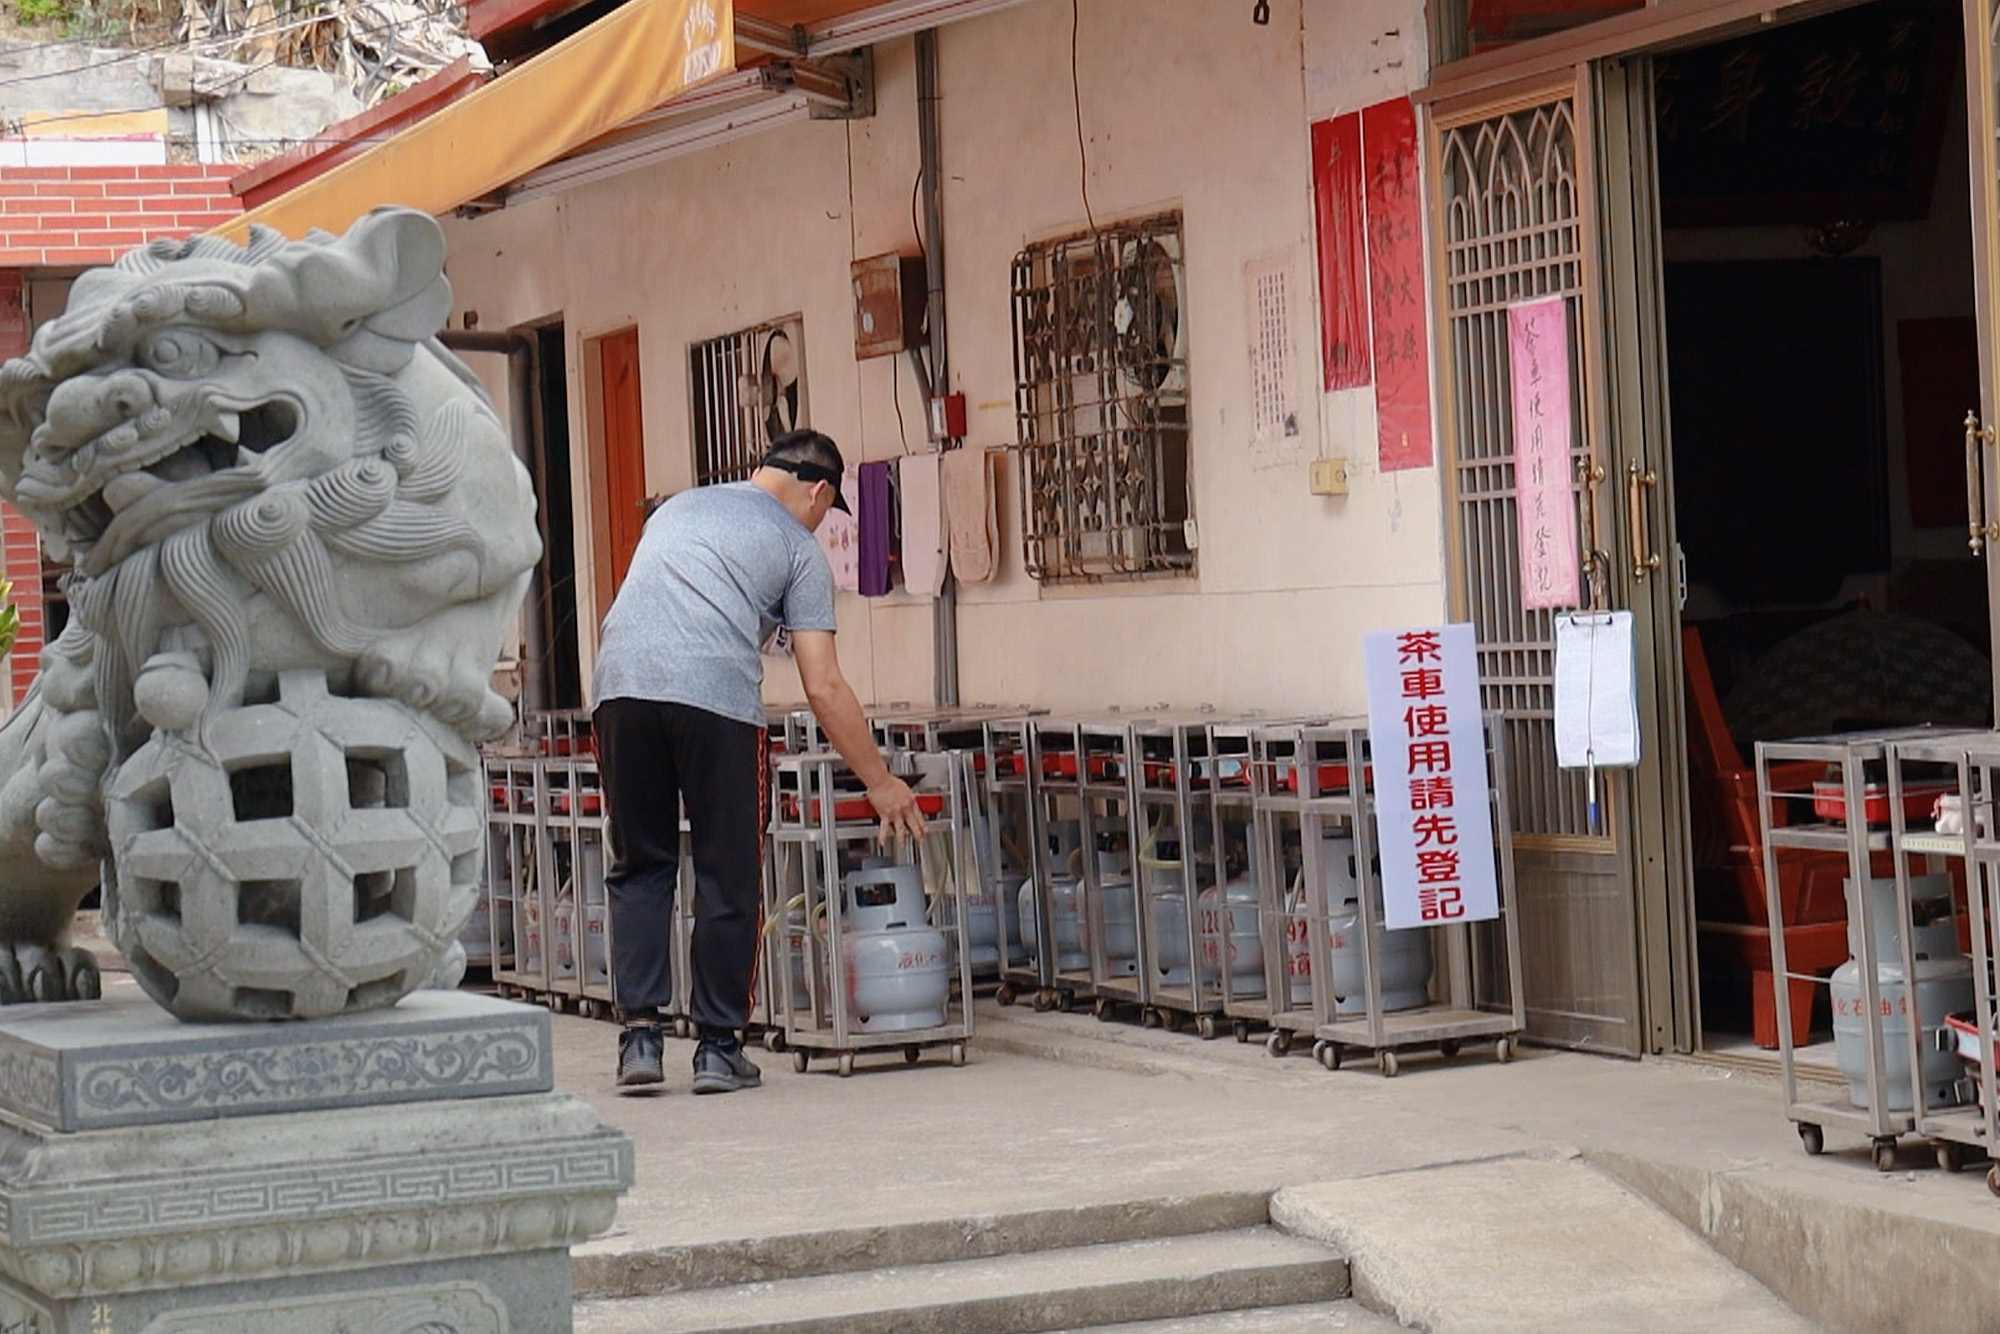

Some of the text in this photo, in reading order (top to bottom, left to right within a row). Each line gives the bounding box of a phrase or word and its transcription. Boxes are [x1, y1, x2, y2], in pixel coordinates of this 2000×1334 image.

[1396, 630, 1465, 921] 茶車使用請先登記
